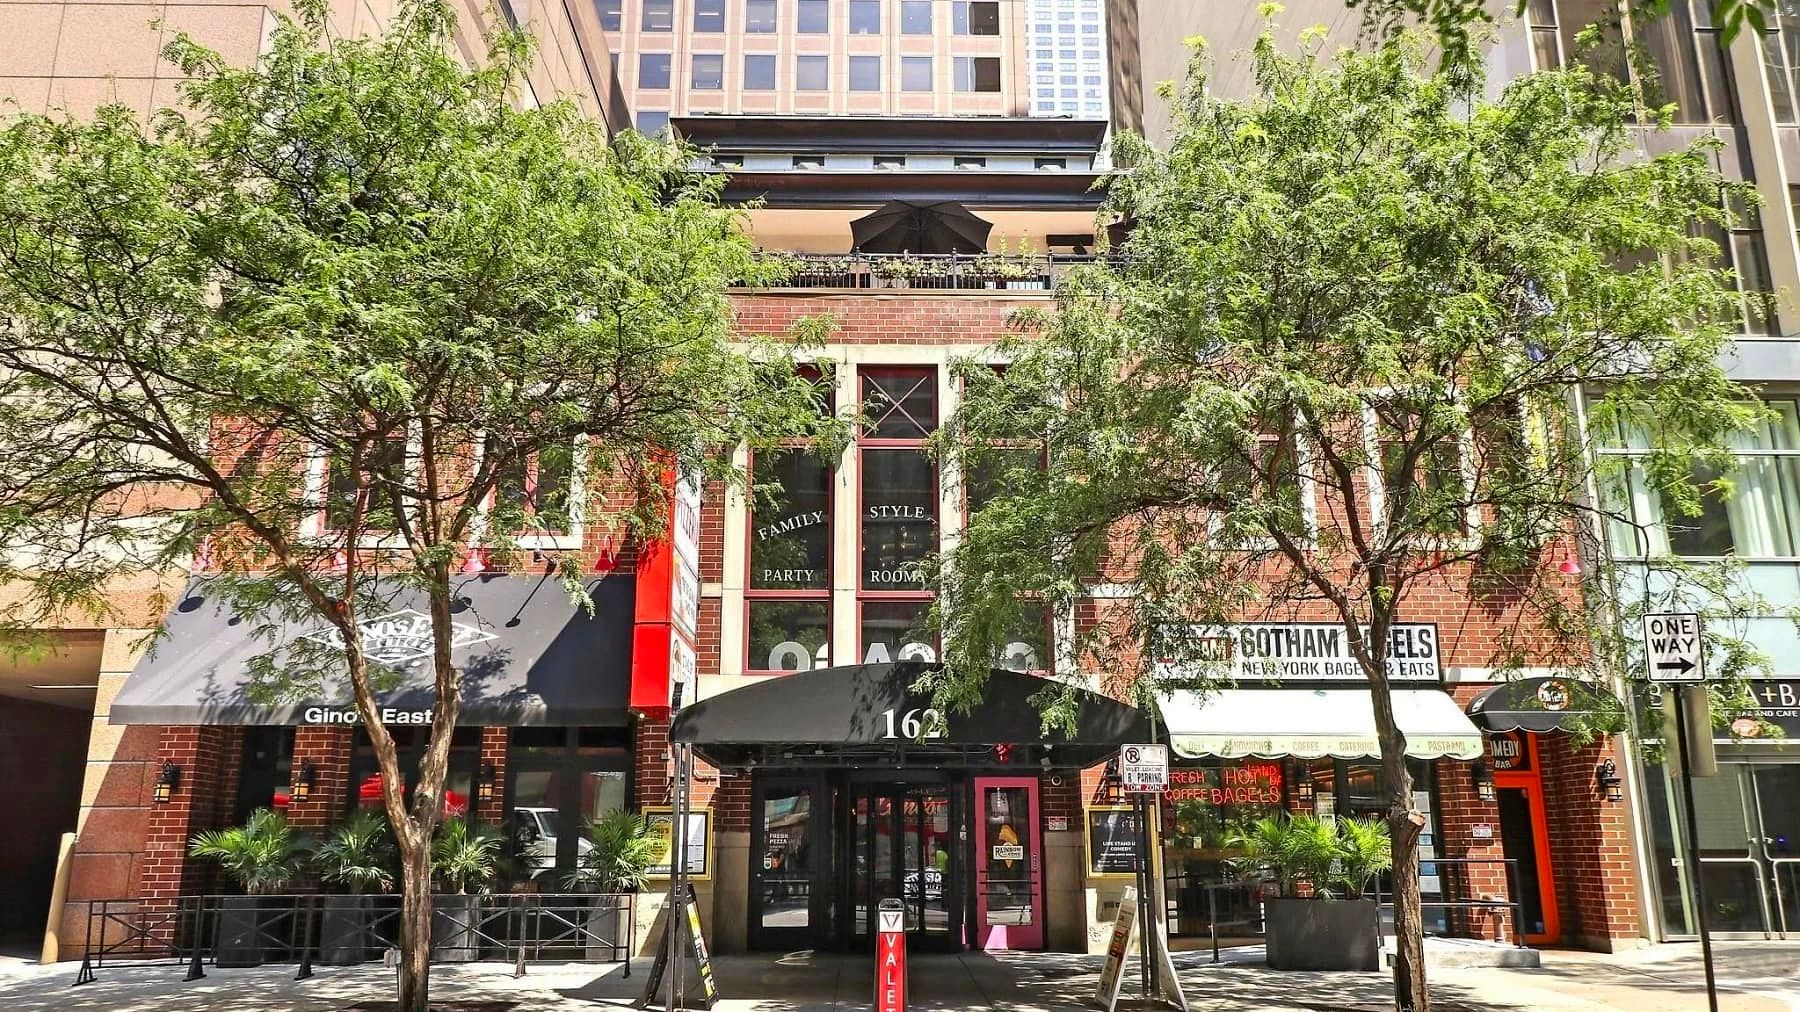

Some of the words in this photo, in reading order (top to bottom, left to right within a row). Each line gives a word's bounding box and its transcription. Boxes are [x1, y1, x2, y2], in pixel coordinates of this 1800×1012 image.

[758, 510, 824, 541] FAMILY
[870, 505, 925, 519] STYLE
[764, 569, 815, 582] PARTY
[1651, 619, 1693, 635] ONE
[1240, 629, 1338, 658] GOTHAM
[1651, 638, 1695, 653] WAY
[1281, 662, 1319, 676] YORK
[1400, 662, 1434, 676] EATS
[305, 708, 367, 724] Gino'
[383, 709, 434, 724] East
[880, 708, 942, 740] 162
[1292, 741, 1320, 751] COFFEE
[1339, 741, 1376, 751] CATERING
[1427, 741, 1466, 752] PASTRAMI
[1490, 739, 1520, 757] MEDY
[1494, 760, 1512, 769] BAR
[1137, 772, 1163, 784] PARKING
[1126, 783, 1141, 791] TOW
[1144, 783, 1164, 791] ZONE
[1165, 788, 1209, 801] COFFEE
[1211, 786, 1281, 805] BAGELS
[885, 933, 897, 1012] VALE
